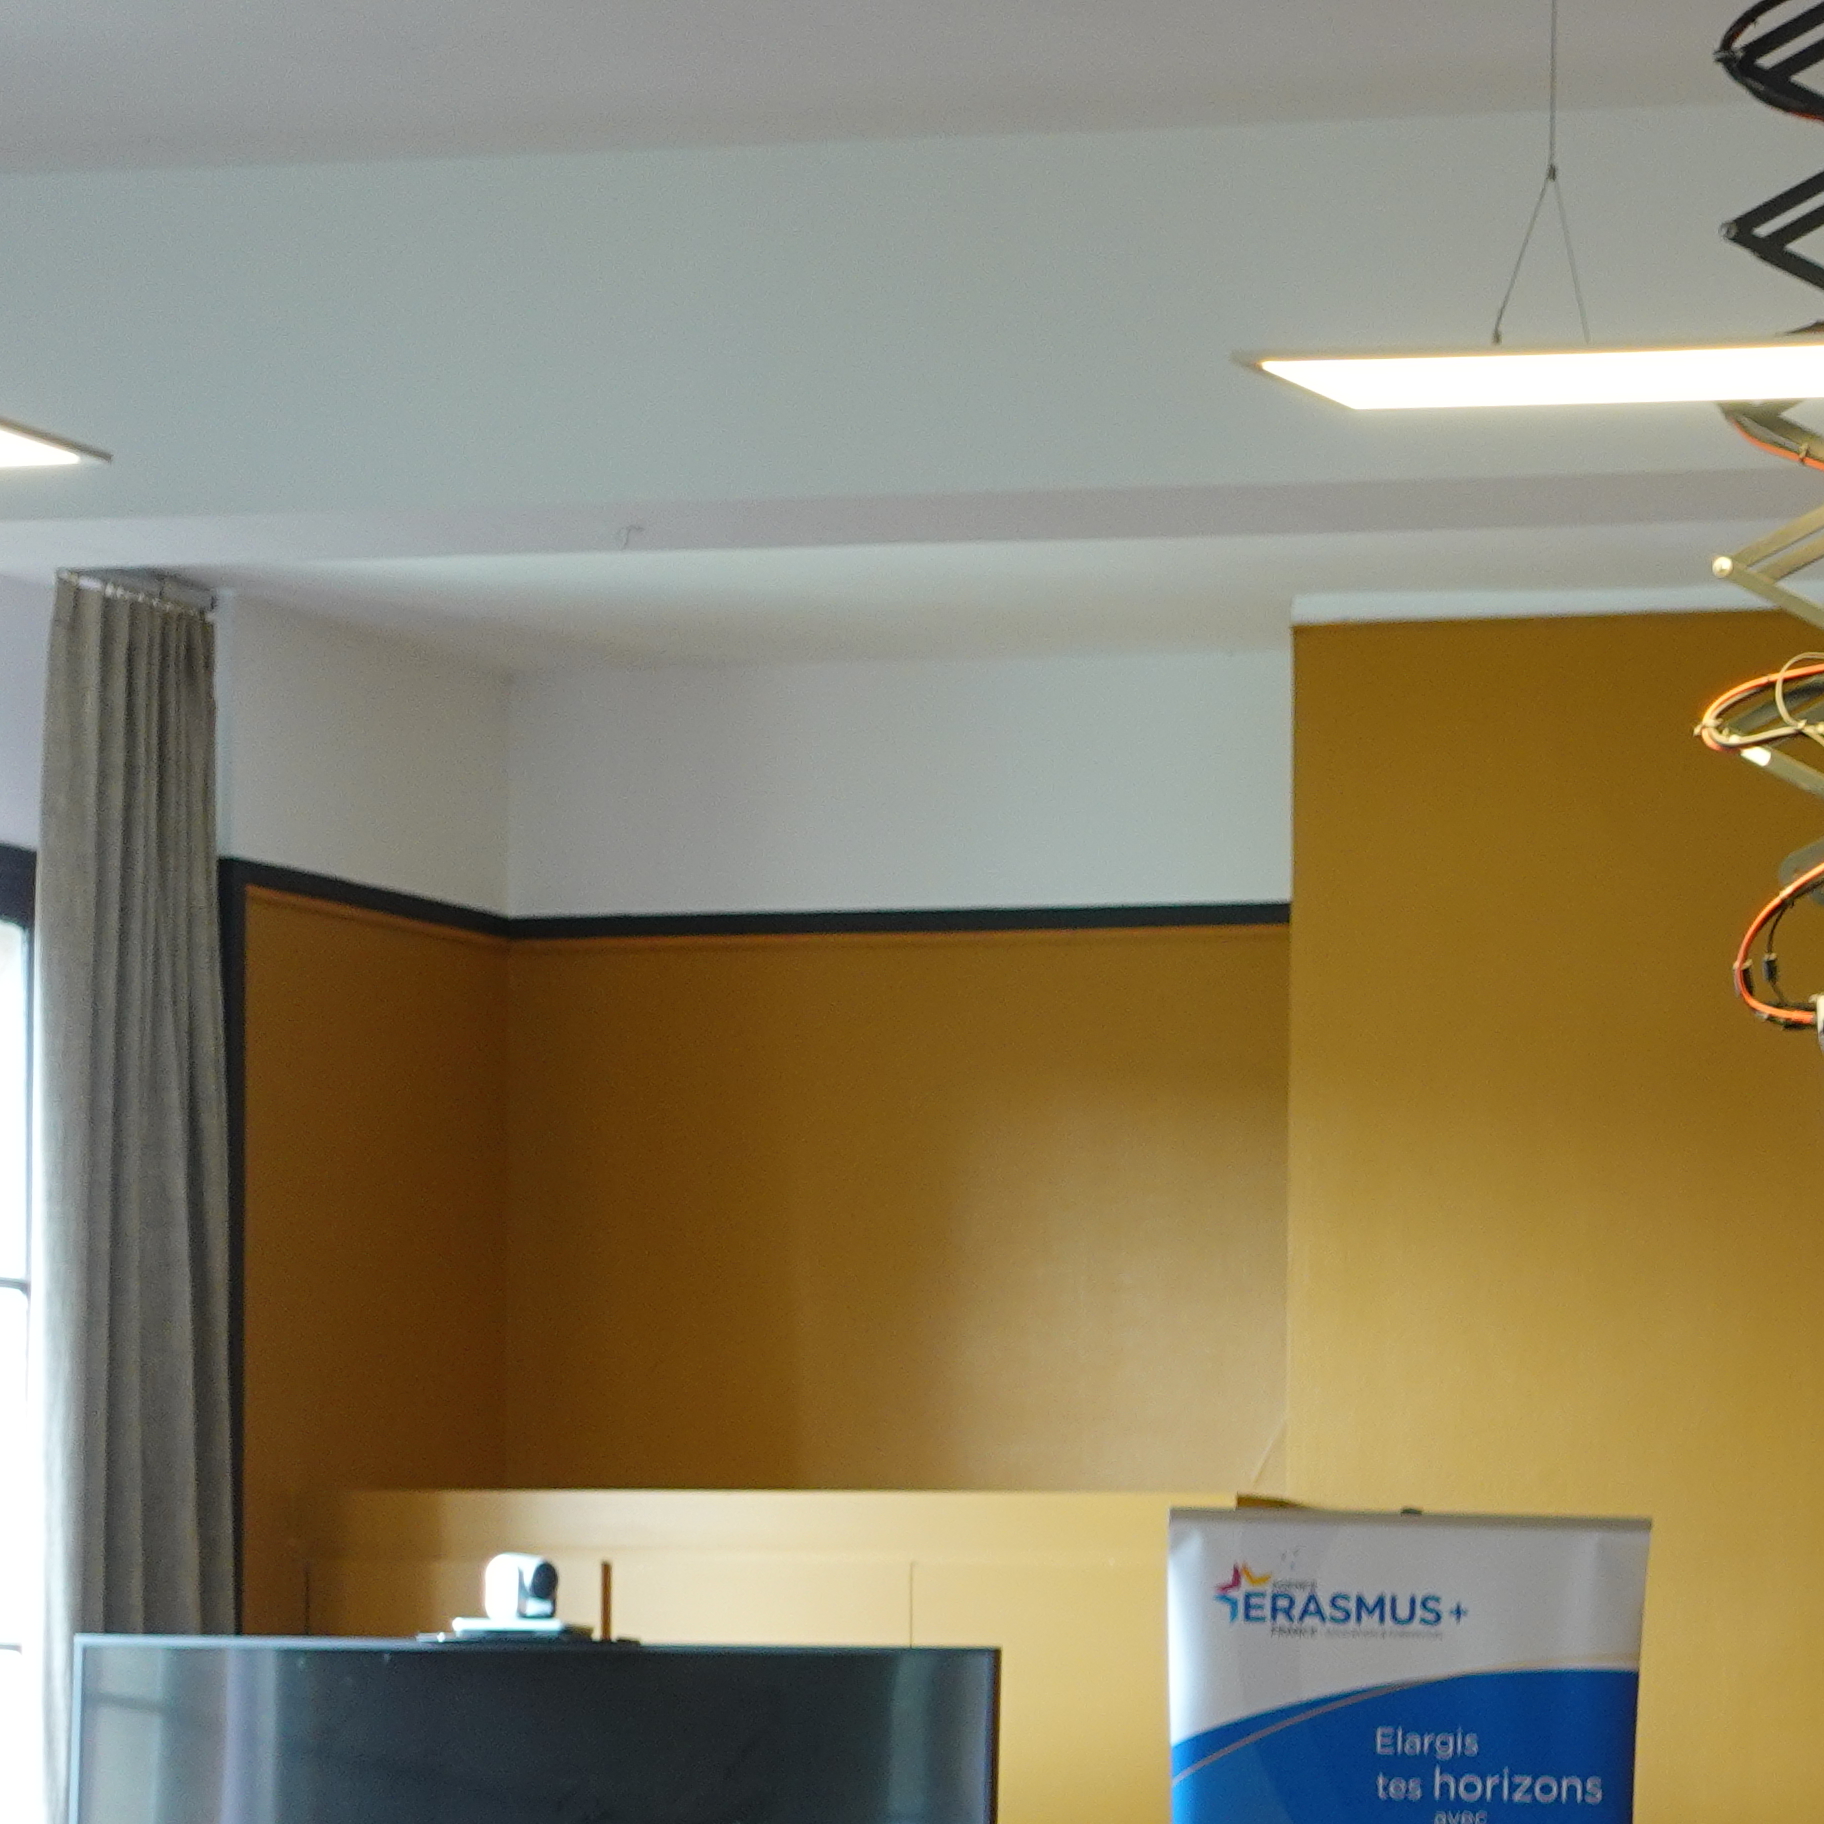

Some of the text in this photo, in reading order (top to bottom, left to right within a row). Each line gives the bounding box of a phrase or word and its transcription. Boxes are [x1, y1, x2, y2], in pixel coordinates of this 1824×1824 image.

[1375, 1726, 1479, 1761] Elargis
[1377, 1764, 1603, 1805] tes horizons
